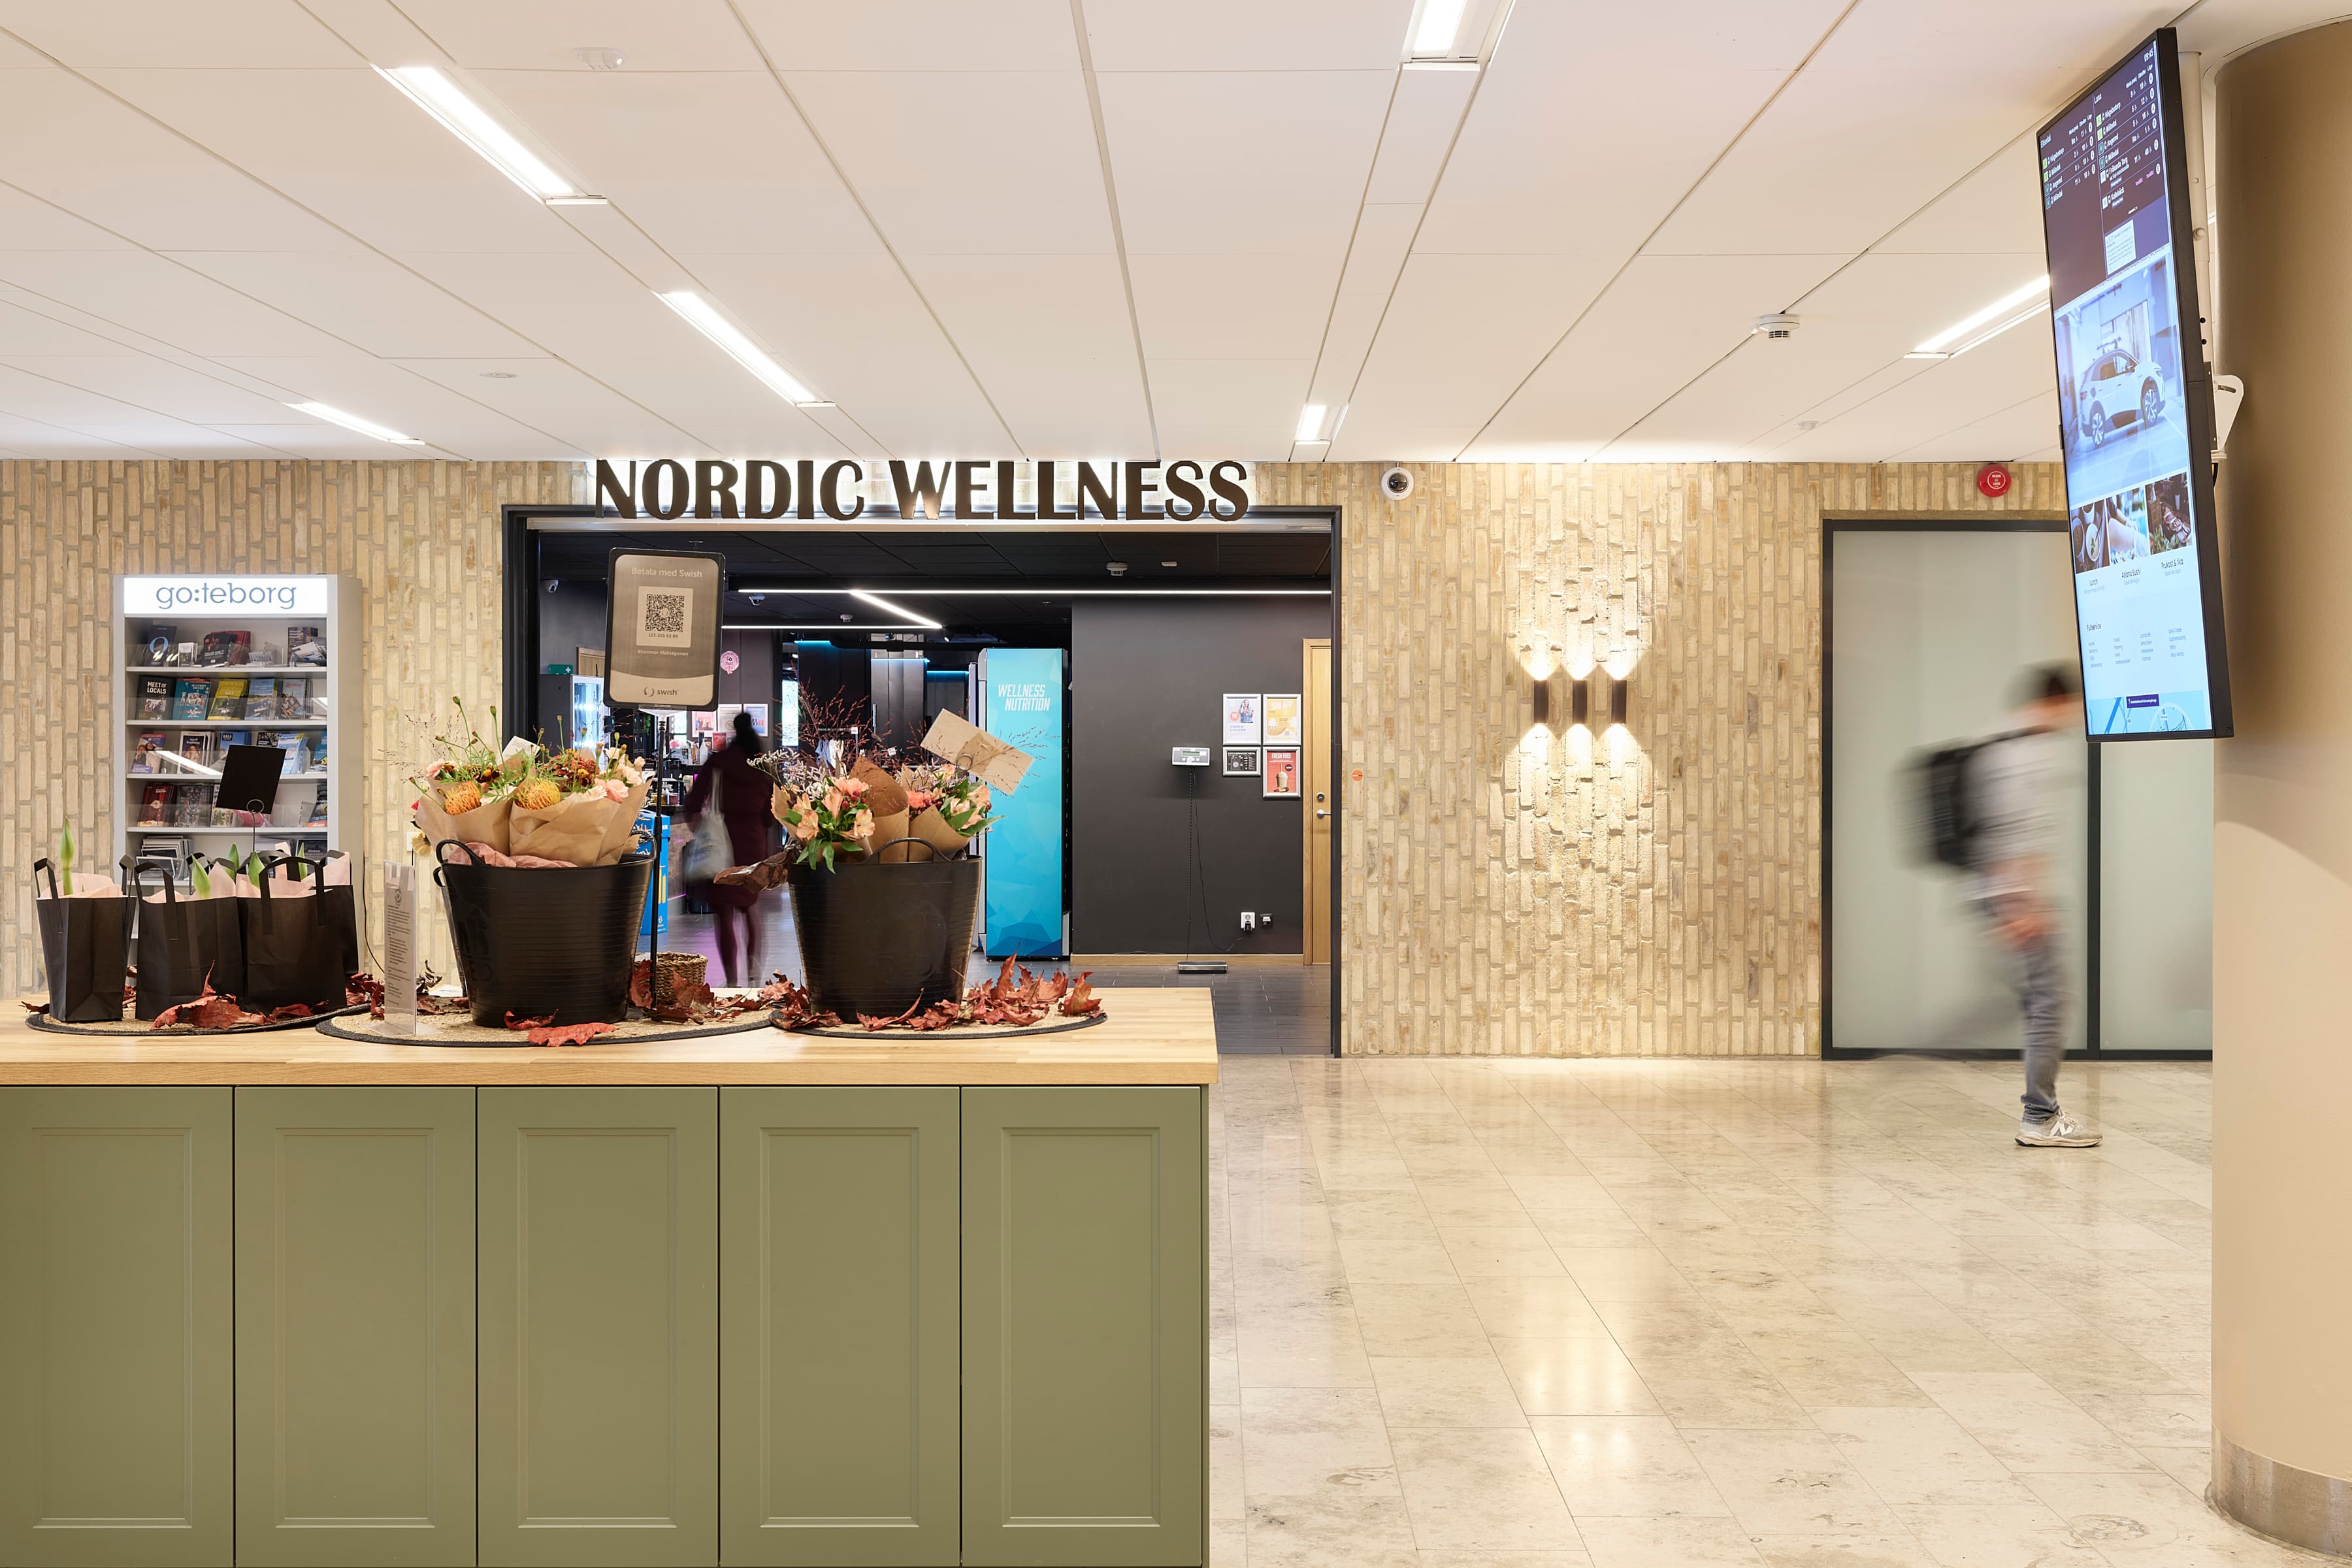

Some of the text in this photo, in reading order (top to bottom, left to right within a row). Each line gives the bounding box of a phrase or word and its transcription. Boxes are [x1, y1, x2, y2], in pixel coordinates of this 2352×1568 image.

[2144, 48, 2153, 61] 09:45
[596, 459, 1249, 521] NORDIC WELLNESS
[632, 567, 657, 576] Betala
[679, 569, 702, 578] Swish
[156, 583, 297, 609] go:teborg
[998, 684, 1045, 698] WELLNESS
[1005, 697, 1051, 711] NUTRITION
